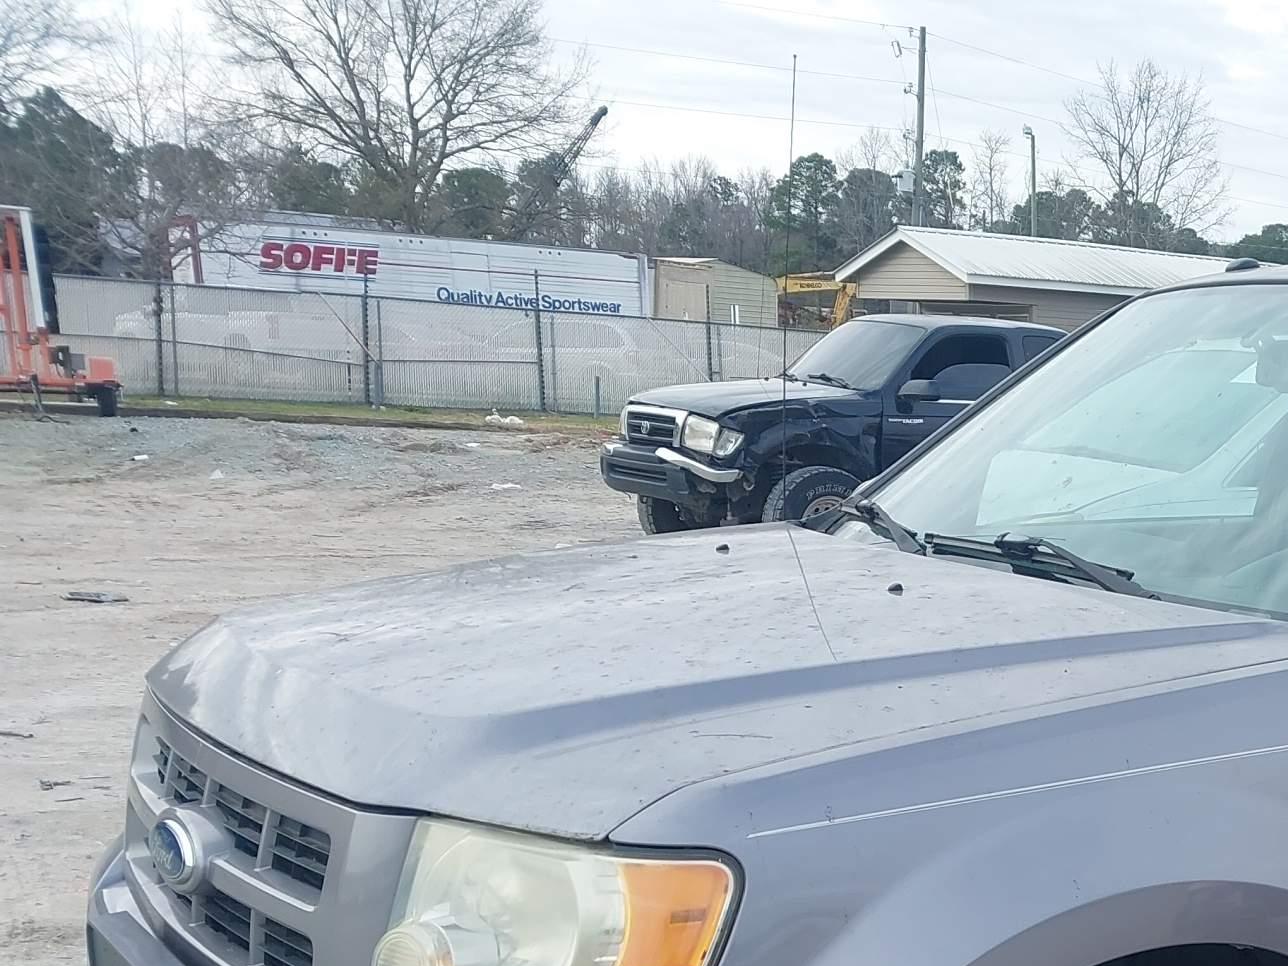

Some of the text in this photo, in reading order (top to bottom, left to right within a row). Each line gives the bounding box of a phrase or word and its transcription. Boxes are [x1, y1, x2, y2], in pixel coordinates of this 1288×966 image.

[436, 286, 622, 314] Quality Active Sportswear
